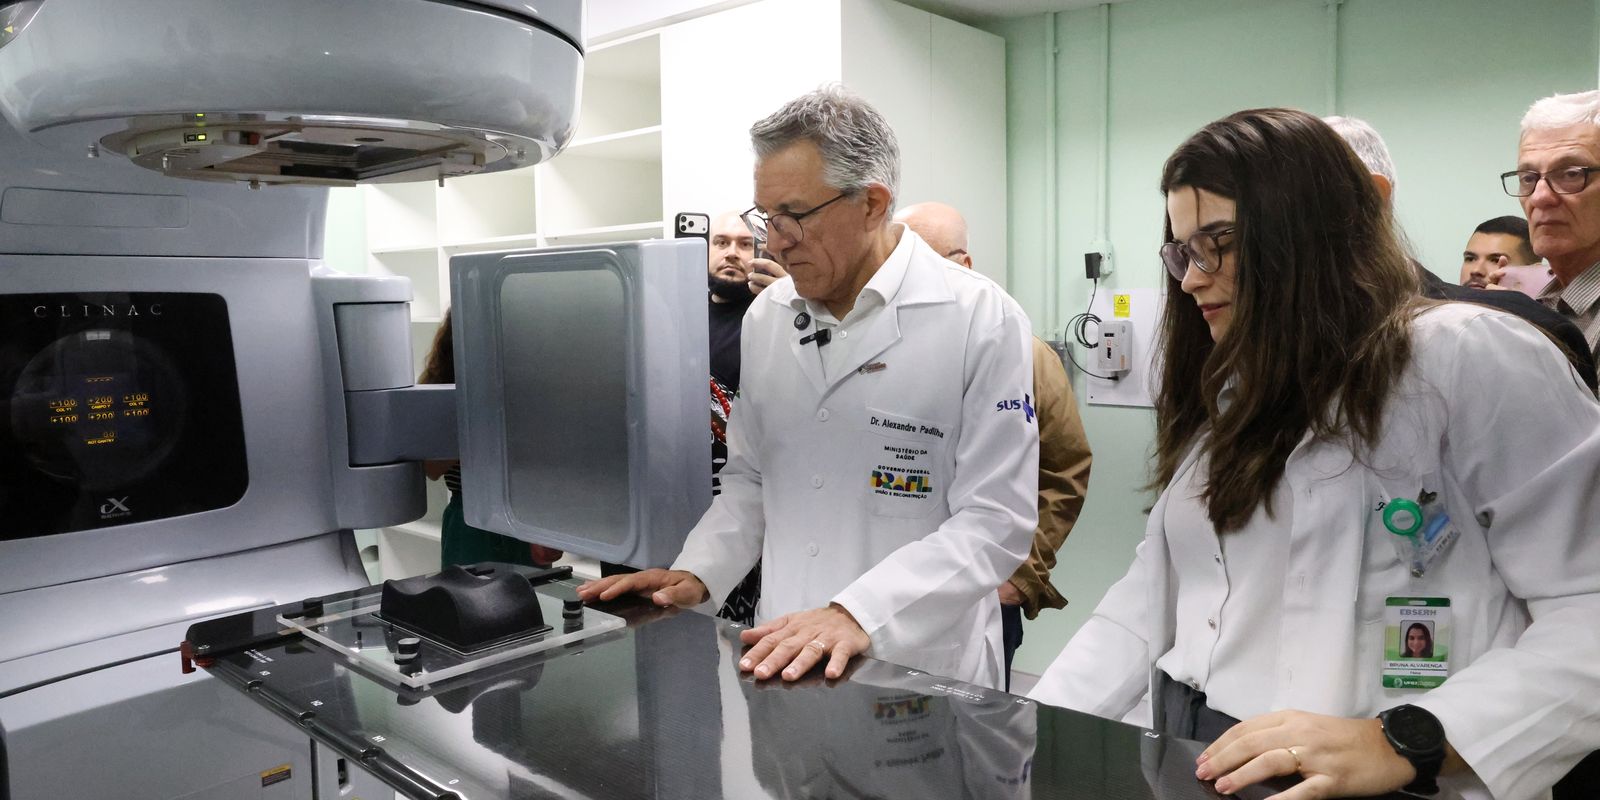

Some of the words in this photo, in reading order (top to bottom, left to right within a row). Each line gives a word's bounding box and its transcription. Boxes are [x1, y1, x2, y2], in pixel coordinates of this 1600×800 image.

[33, 303, 163, 318] CLINAC
[996, 399, 1021, 412] SUS
[870, 416, 880, 426] Dr.
[881, 418, 917, 433] Alexandre
[919, 425, 944, 439] Padilha
[884, 445, 919, 455] MINISTÉRIO
[895, 453, 915, 461] SAÚDE
[877, 464, 906, 473] GOVERNO
[870, 470, 933, 493] BRASIL
[1399, 608, 1437, 616] EBSERH
